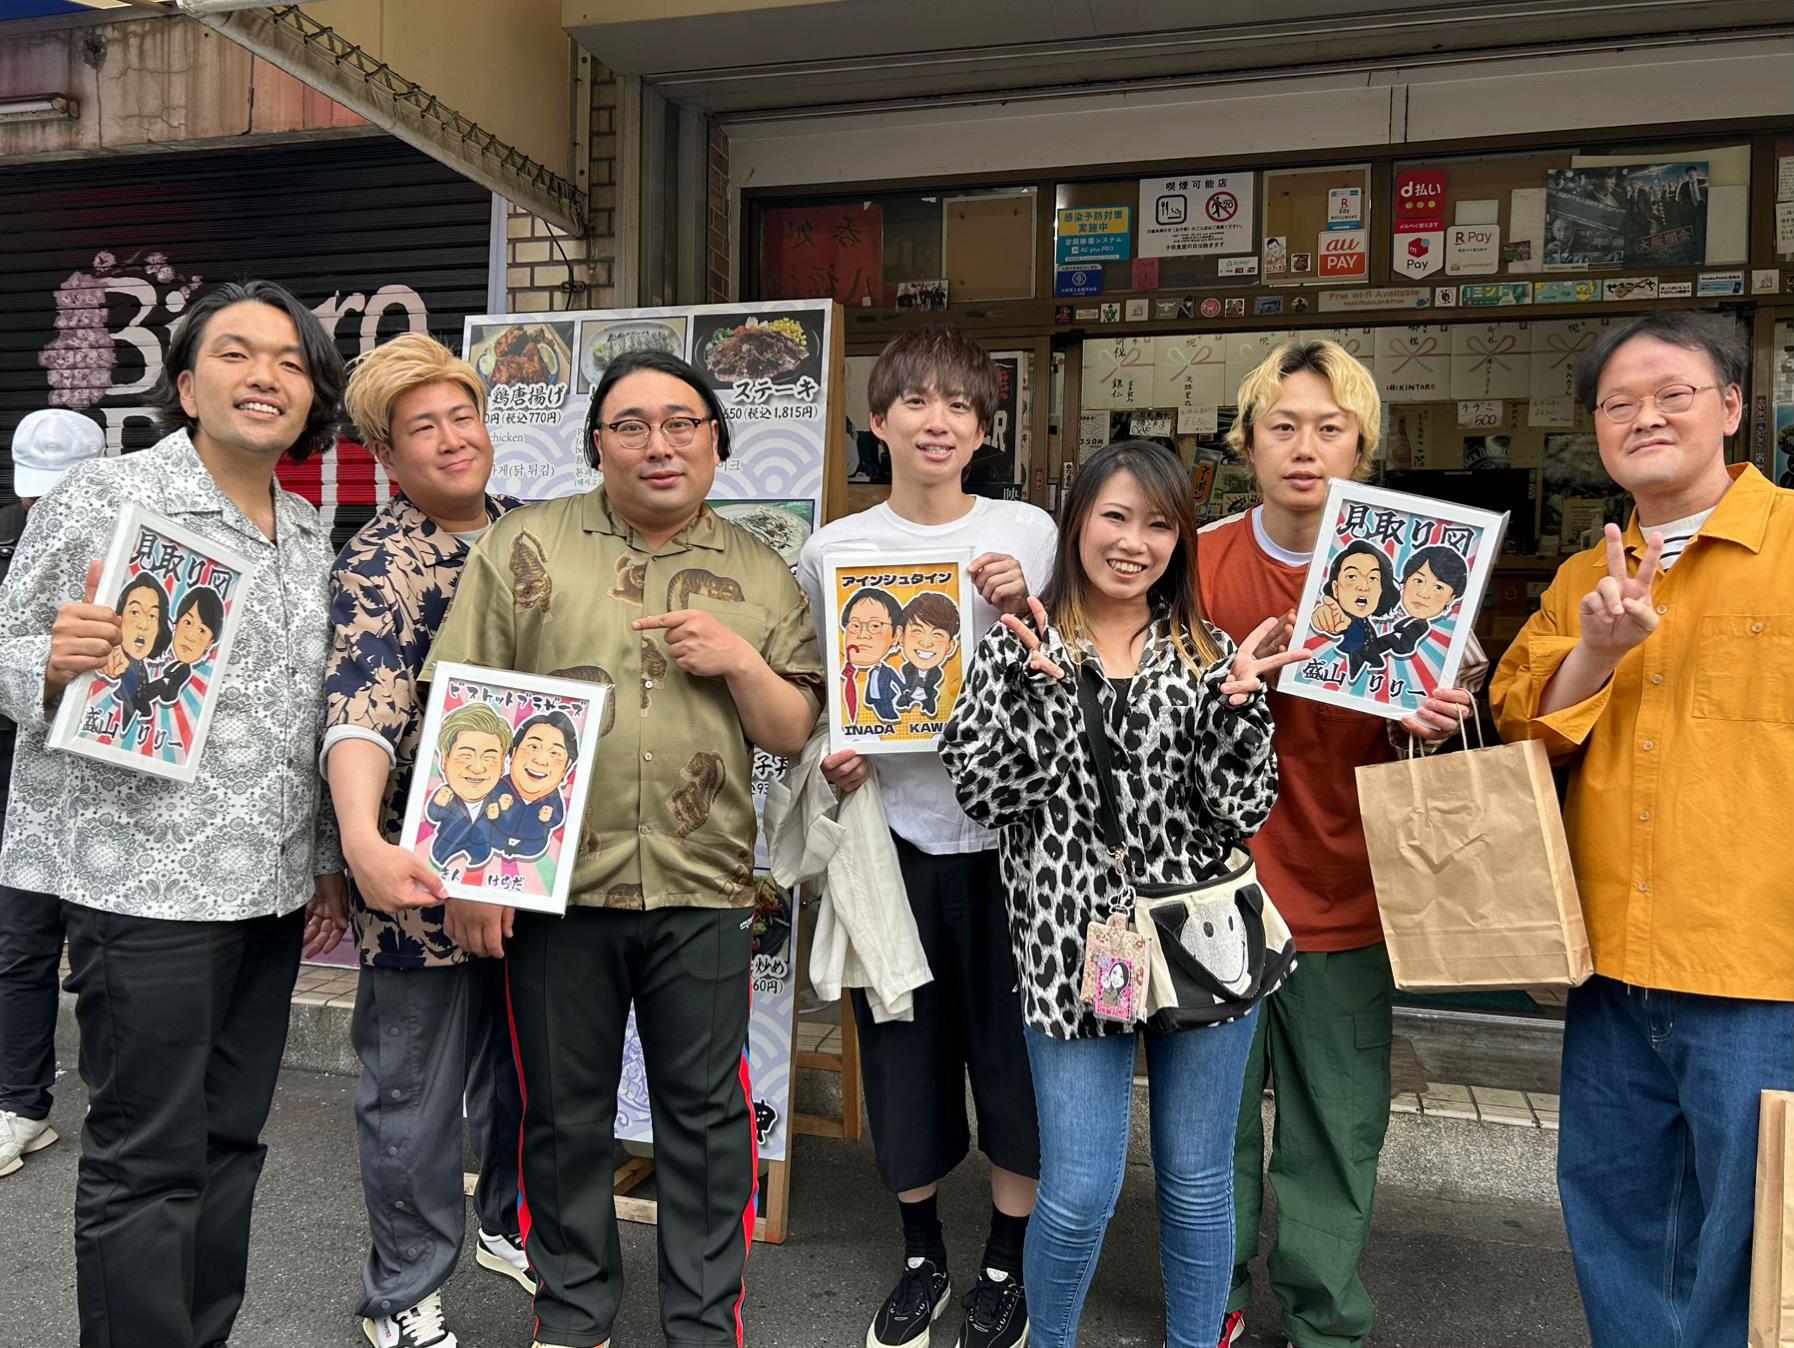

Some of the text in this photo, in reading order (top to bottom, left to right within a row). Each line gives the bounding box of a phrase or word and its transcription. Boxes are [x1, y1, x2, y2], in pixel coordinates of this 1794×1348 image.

[1165, 178, 1228, 191] 喫煙可能店
[1401, 181, 1441, 198] d払い
[1078, 222, 1108, 233] 実施中
[1326, 239, 1360, 251] au
[1468, 231, 1492, 244] Pay
[1327, 255, 1358, 270] PAY
[1407, 259, 1429, 271] Pay
[491, 384, 565, 407] 鶏唐揚げ
[735, 378, 816, 399] ステーキ
[1336, 504, 1475, 557] 見取り図
[129, 531, 235, 601] 見取り図
[841, 572, 952, 587] アインシュタイン
[1302, 657, 1346, 686] 盛山
[449, 681, 587, 716] ビスケットブラザーズ
[80, 706, 118, 738] 盛山
[844, 722, 947, 736] INADA KAW
